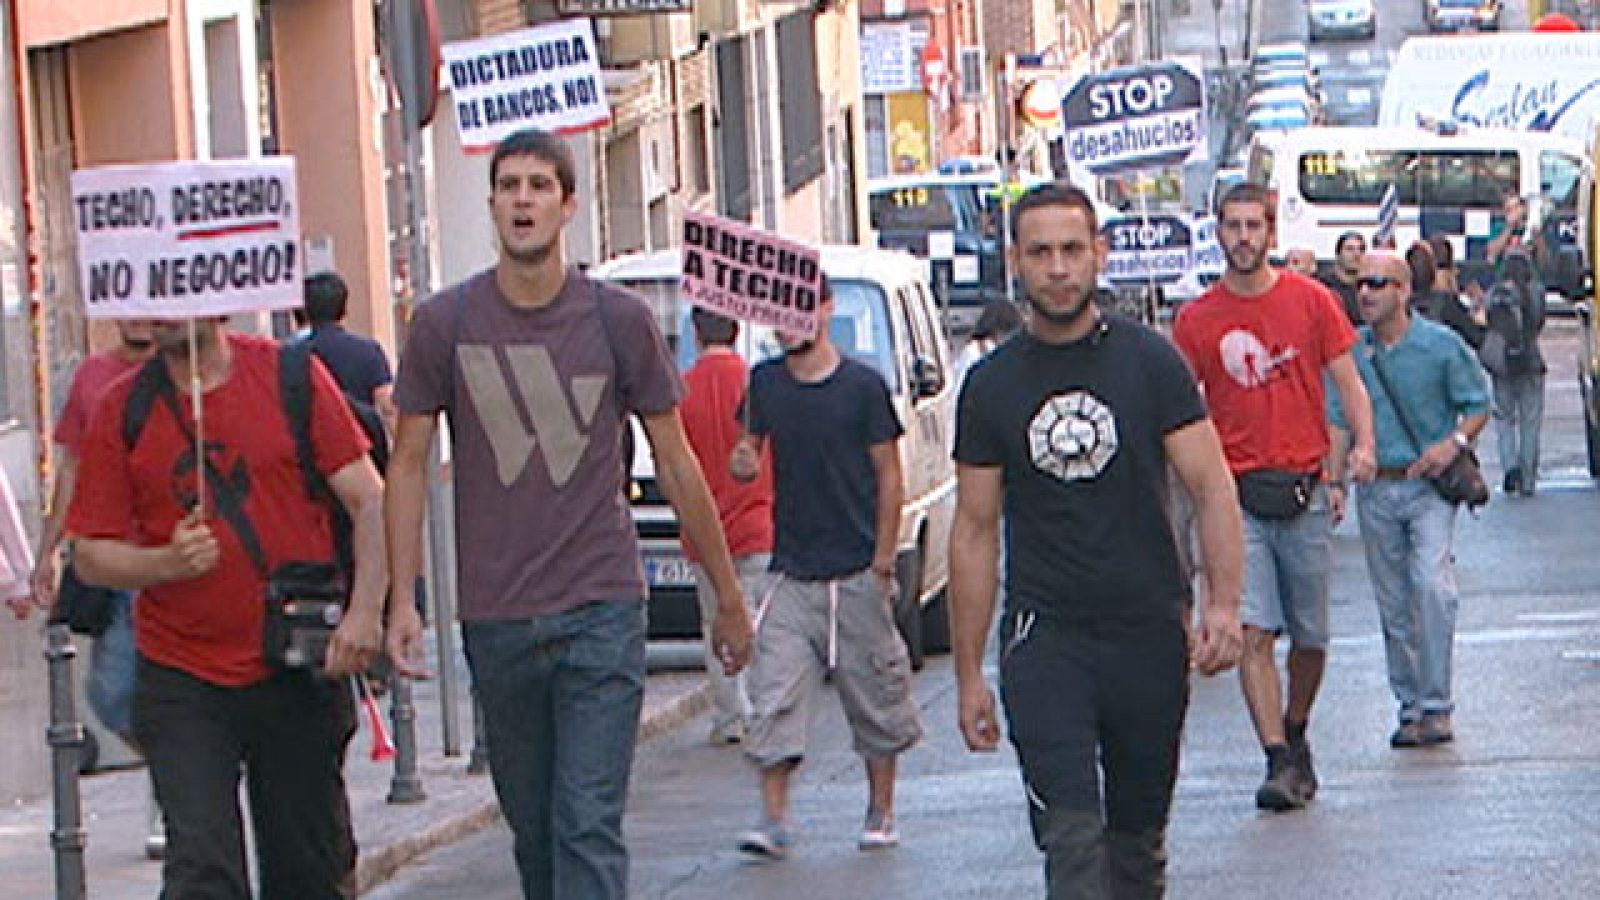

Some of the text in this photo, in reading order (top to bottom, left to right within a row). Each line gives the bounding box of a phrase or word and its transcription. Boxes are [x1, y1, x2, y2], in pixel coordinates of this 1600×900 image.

[450, 35, 590, 91] DICTADURA
[459, 74, 600, 128] DE BANCOS, NO!
[1089, 74, 1175, 118] STOP
[76, 175, 292, 232] TECHO, DERECHO,
[684, 219, 818, 283] DERECHO
[1113, 222, 1172, 246] STOP
[89, 240, 296, 303] NO NEGOCIO!
[683, 249, 816, 313] A TECHO
